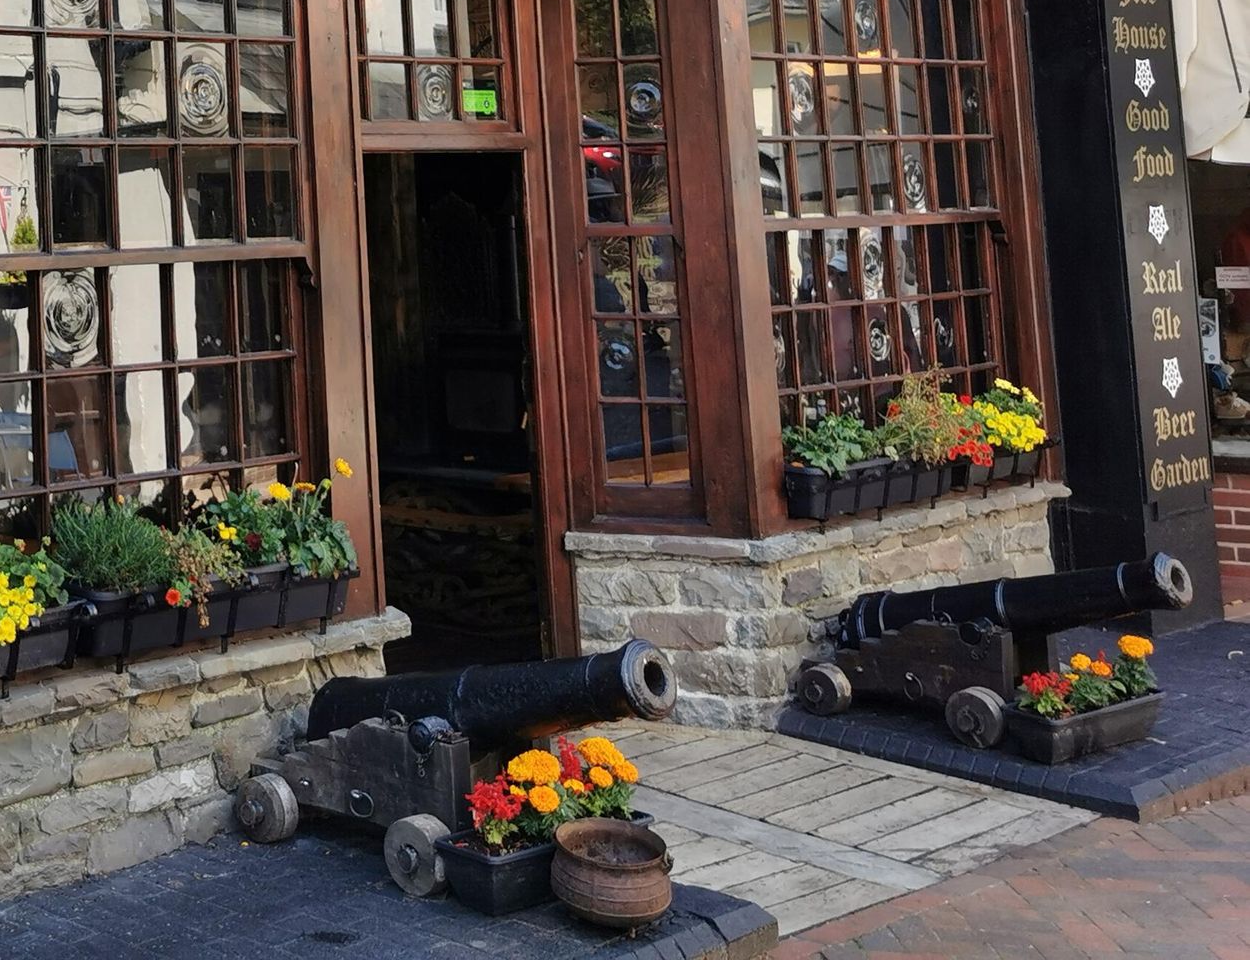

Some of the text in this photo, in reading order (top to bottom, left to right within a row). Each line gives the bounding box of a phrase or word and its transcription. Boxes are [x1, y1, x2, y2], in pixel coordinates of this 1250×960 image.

[1112, 16, 1167, 54] House
[1126, 99, 1170, 132] Good
[1133, 145, 1174, 182] Food
[1141, 260, 1183, 294] Real
[1152, 306, 1181, 341] Ale
[1153, 407, 1196, 447] Beer
[1151, 454, 1210, 491] Garden
